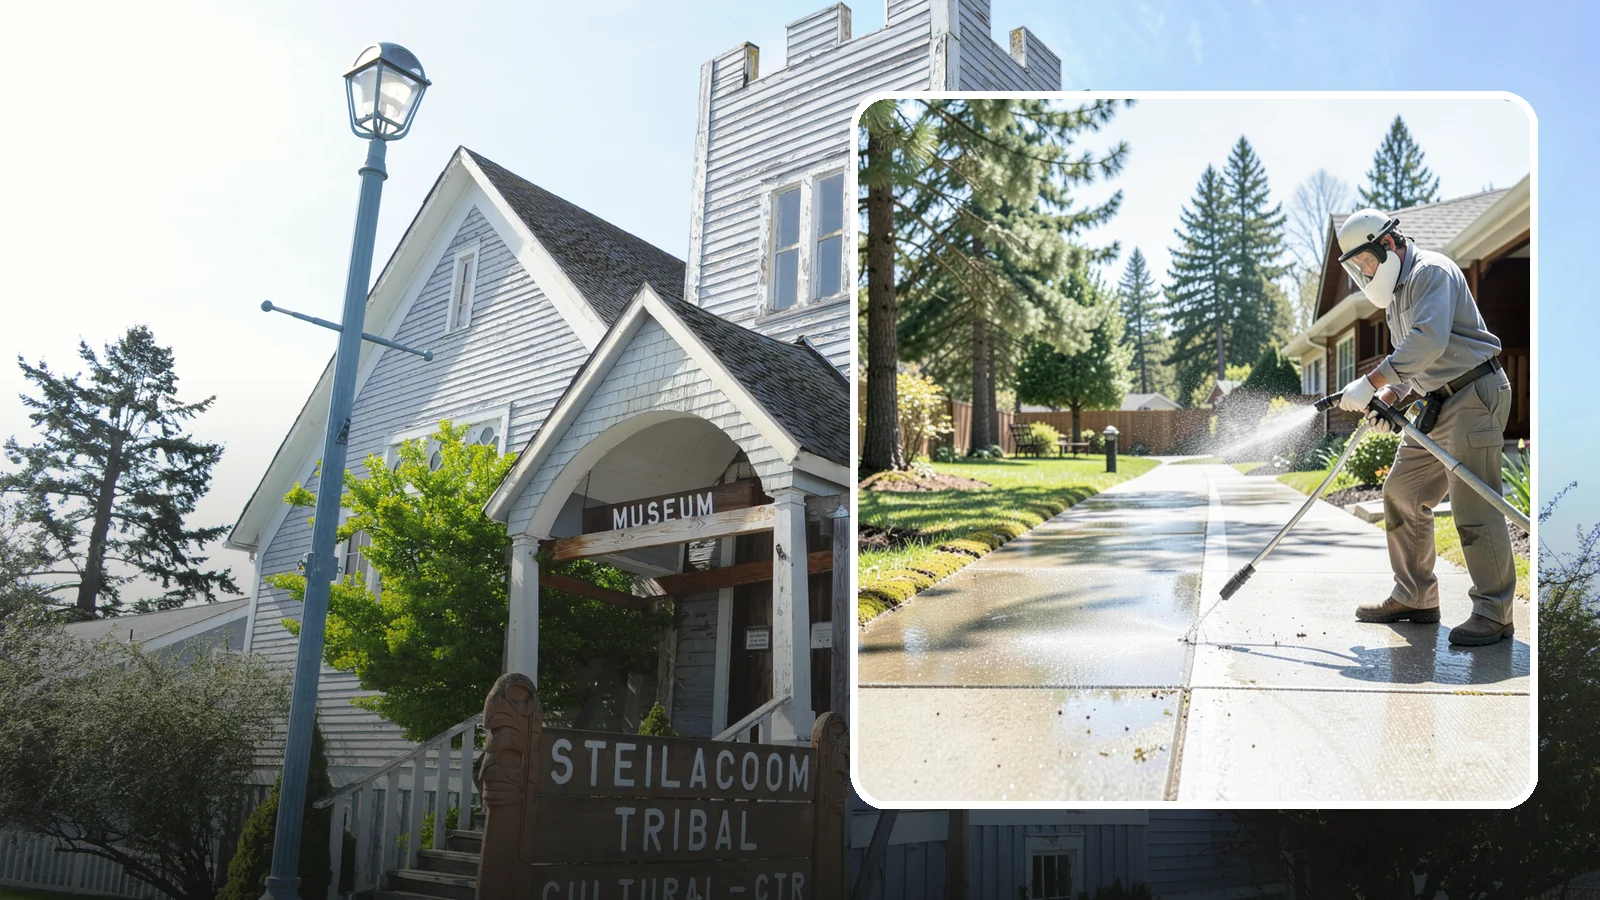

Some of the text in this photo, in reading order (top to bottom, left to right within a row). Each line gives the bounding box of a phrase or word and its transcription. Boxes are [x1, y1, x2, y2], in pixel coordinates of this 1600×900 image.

[612, 491, 713, 531] MUSEUM
[550, 738, 810, 793] STEILACOOM
[614, 806, 758, 853] TRIBAL
